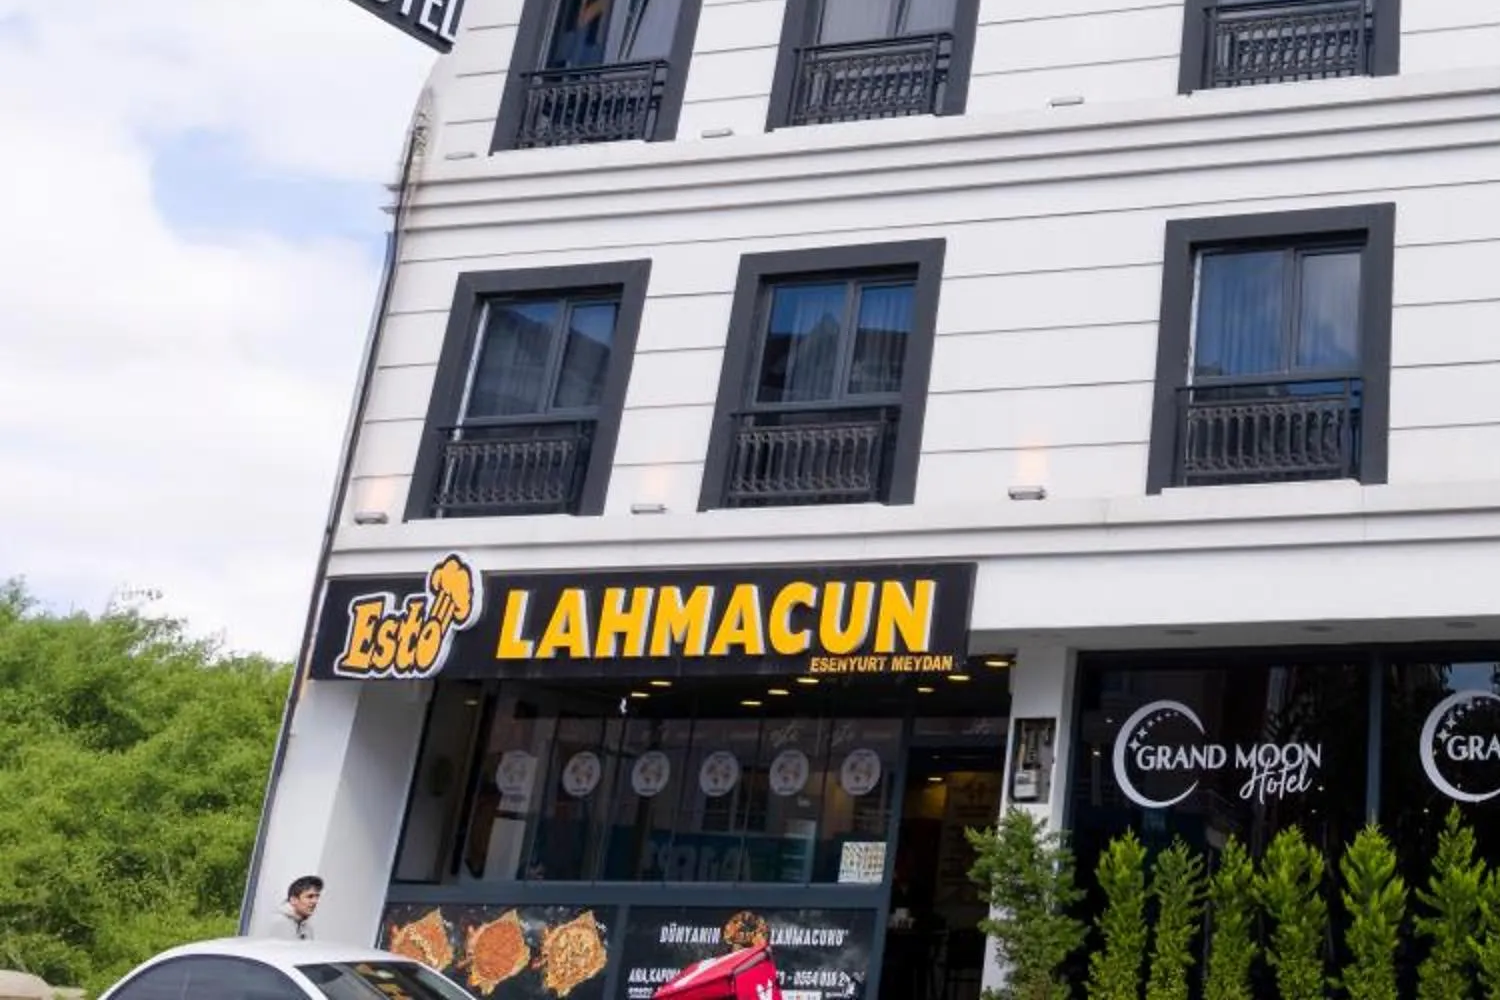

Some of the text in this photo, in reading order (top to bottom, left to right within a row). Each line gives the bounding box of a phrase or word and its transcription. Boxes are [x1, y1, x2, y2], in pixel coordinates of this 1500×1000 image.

[338, 597, 441, 674] Esto
[495, 579, 936, 659] LAHMACUN
[809, 655, 953, 672] ESENYURT MEYDAN
[1136, 743, 1322, 770] GRAND MOON
[1239, 758, 1313, 805] Hotel
